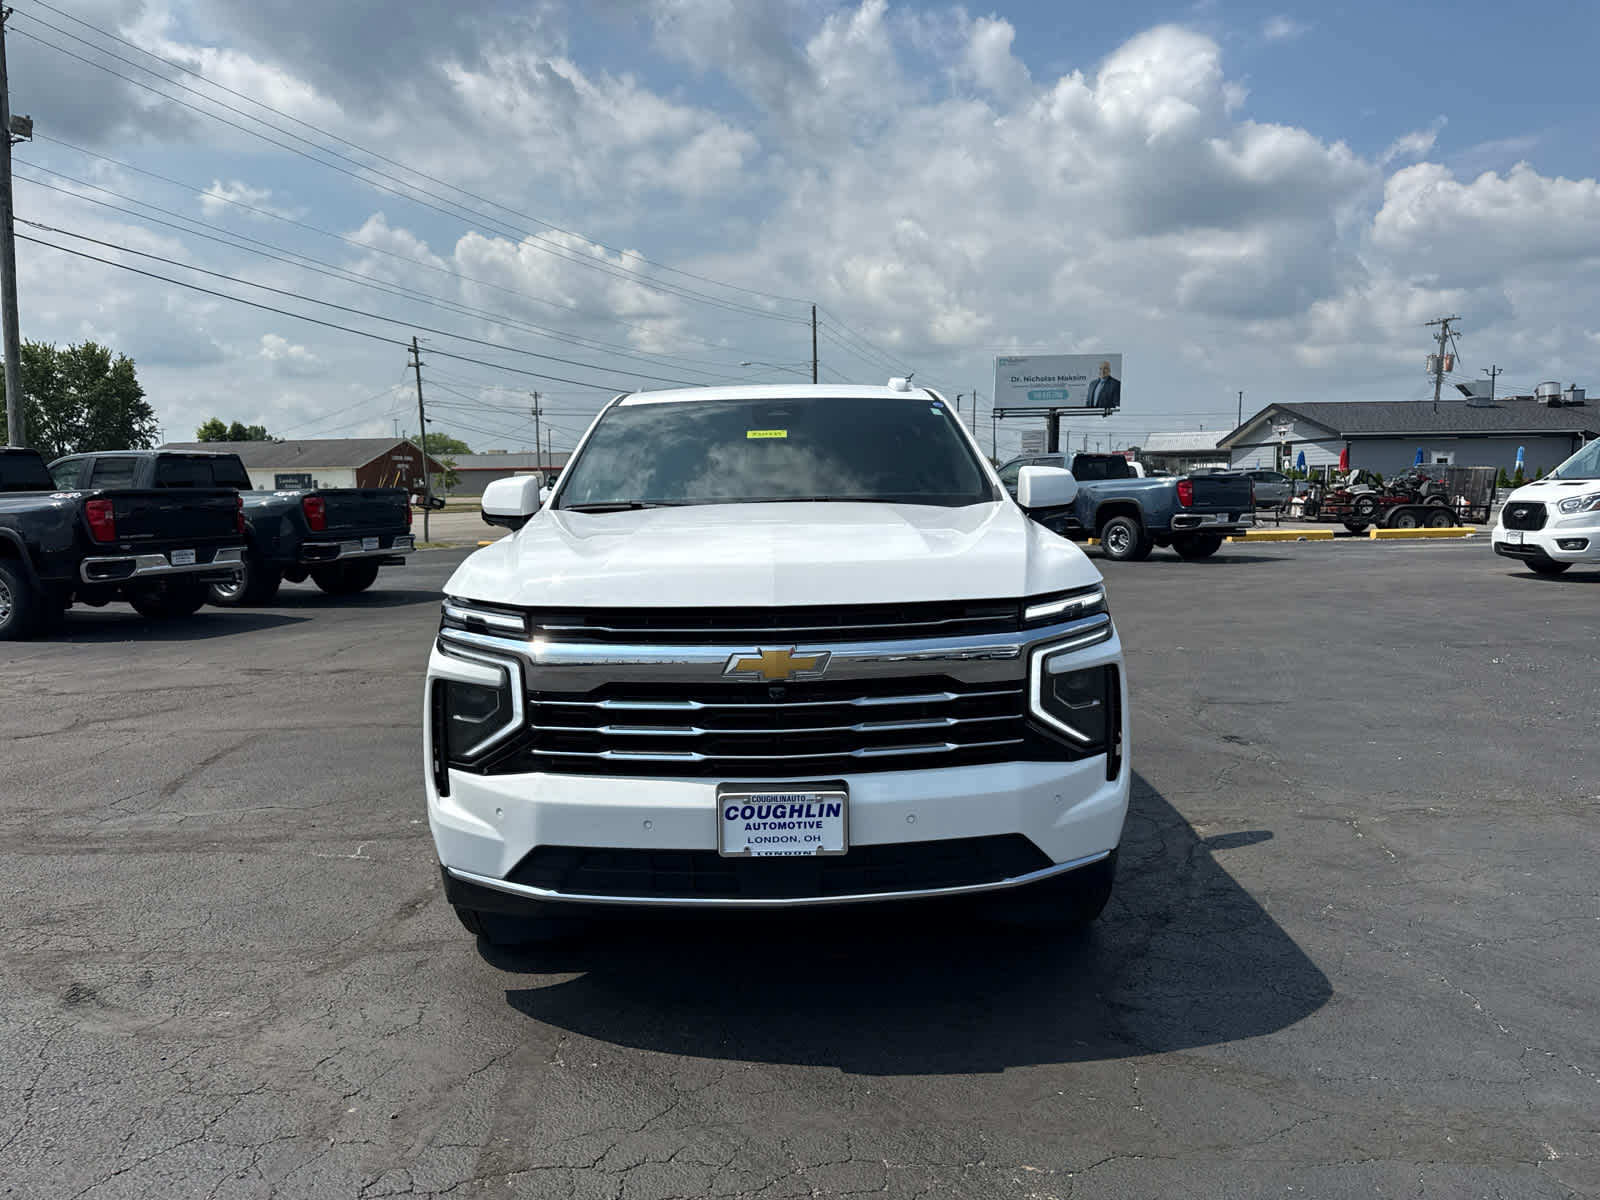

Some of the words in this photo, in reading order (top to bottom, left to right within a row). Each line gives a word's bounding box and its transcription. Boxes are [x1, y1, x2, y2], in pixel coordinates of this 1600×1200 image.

[1023, 375, 1056, 383] Nicholas
[725, 803, 841, 820] COUGHLIN
[745, 821, 823, 831] AUTOMOTIVE
[747, 836, 801, 844] LONDON,
